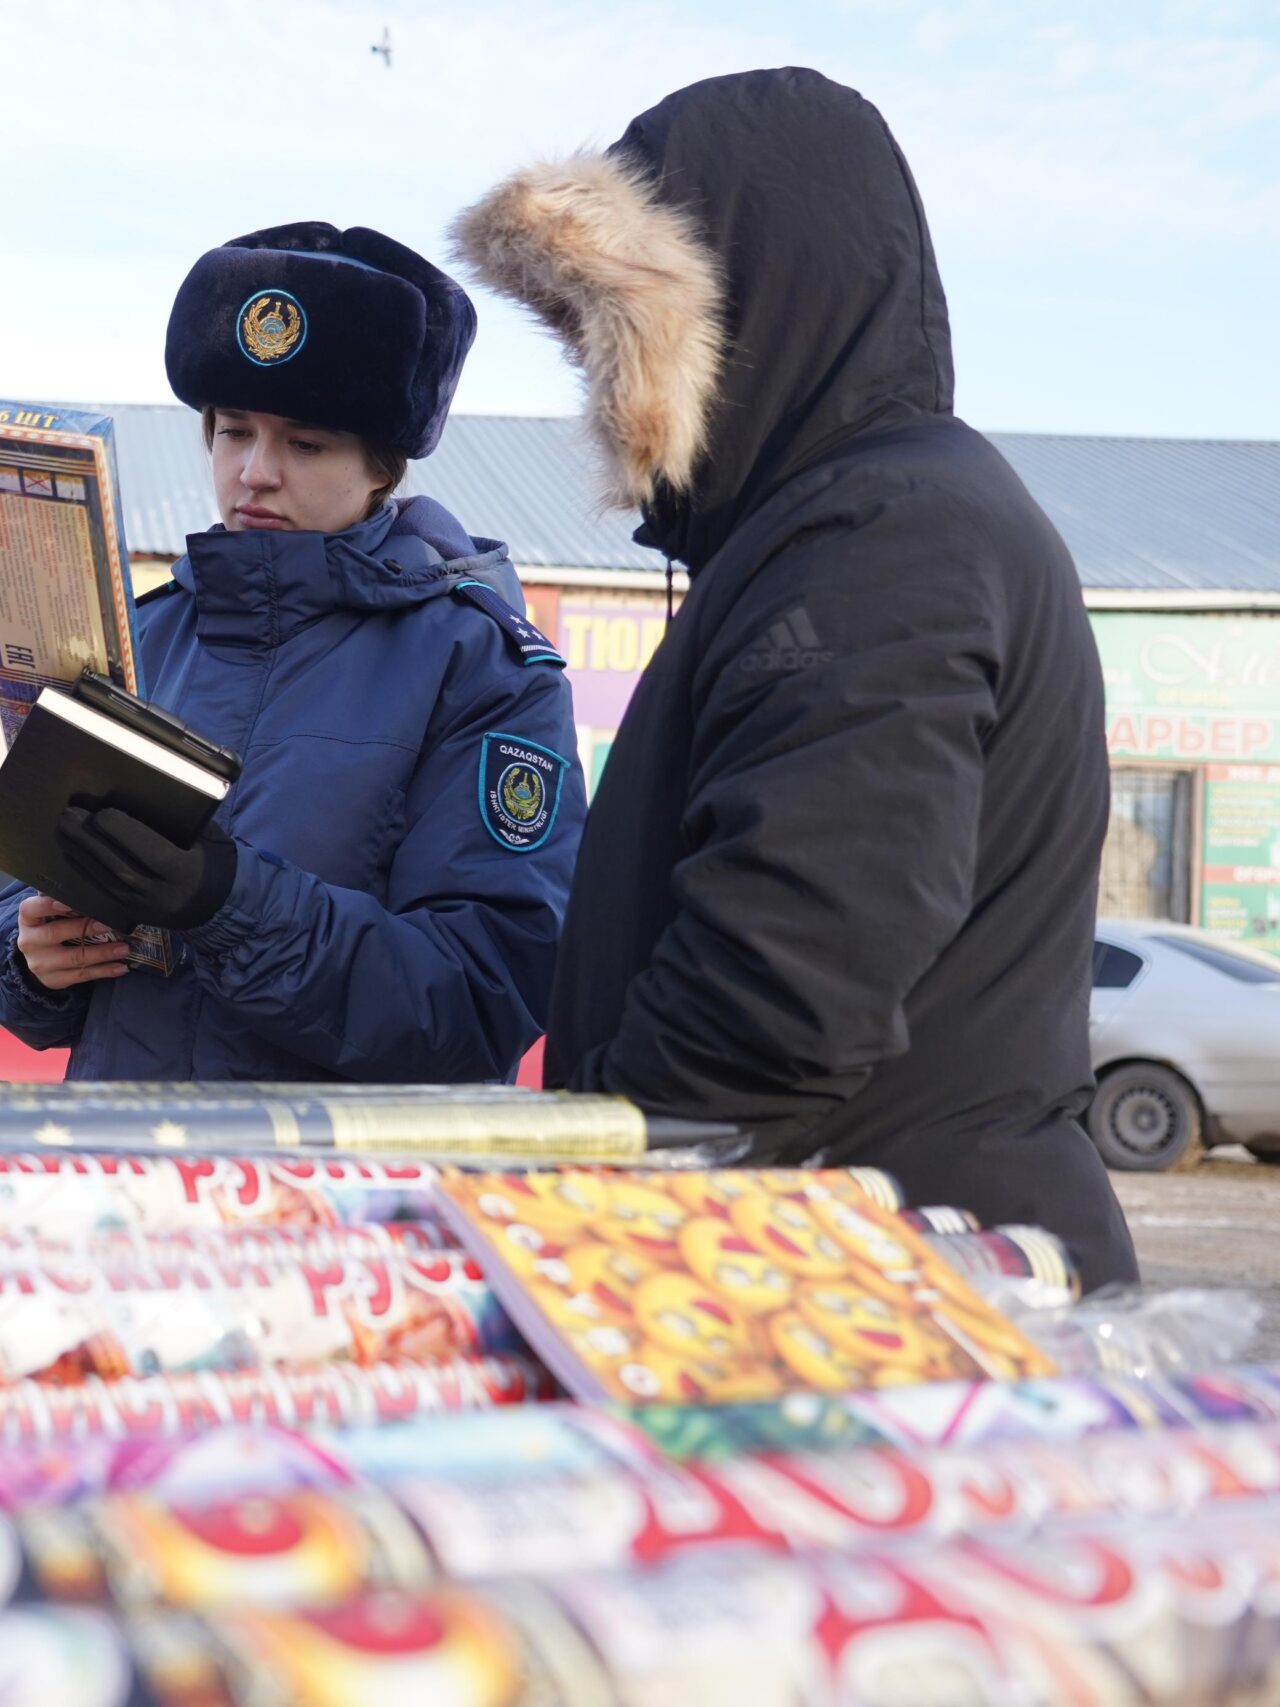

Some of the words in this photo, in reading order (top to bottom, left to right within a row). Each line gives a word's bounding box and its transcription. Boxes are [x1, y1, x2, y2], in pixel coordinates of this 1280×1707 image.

[15, 411, 60, 428] ШТ
[739, 650, 834, 672] adidas
[500, 745, 553, 772] QAZAQSTAN
